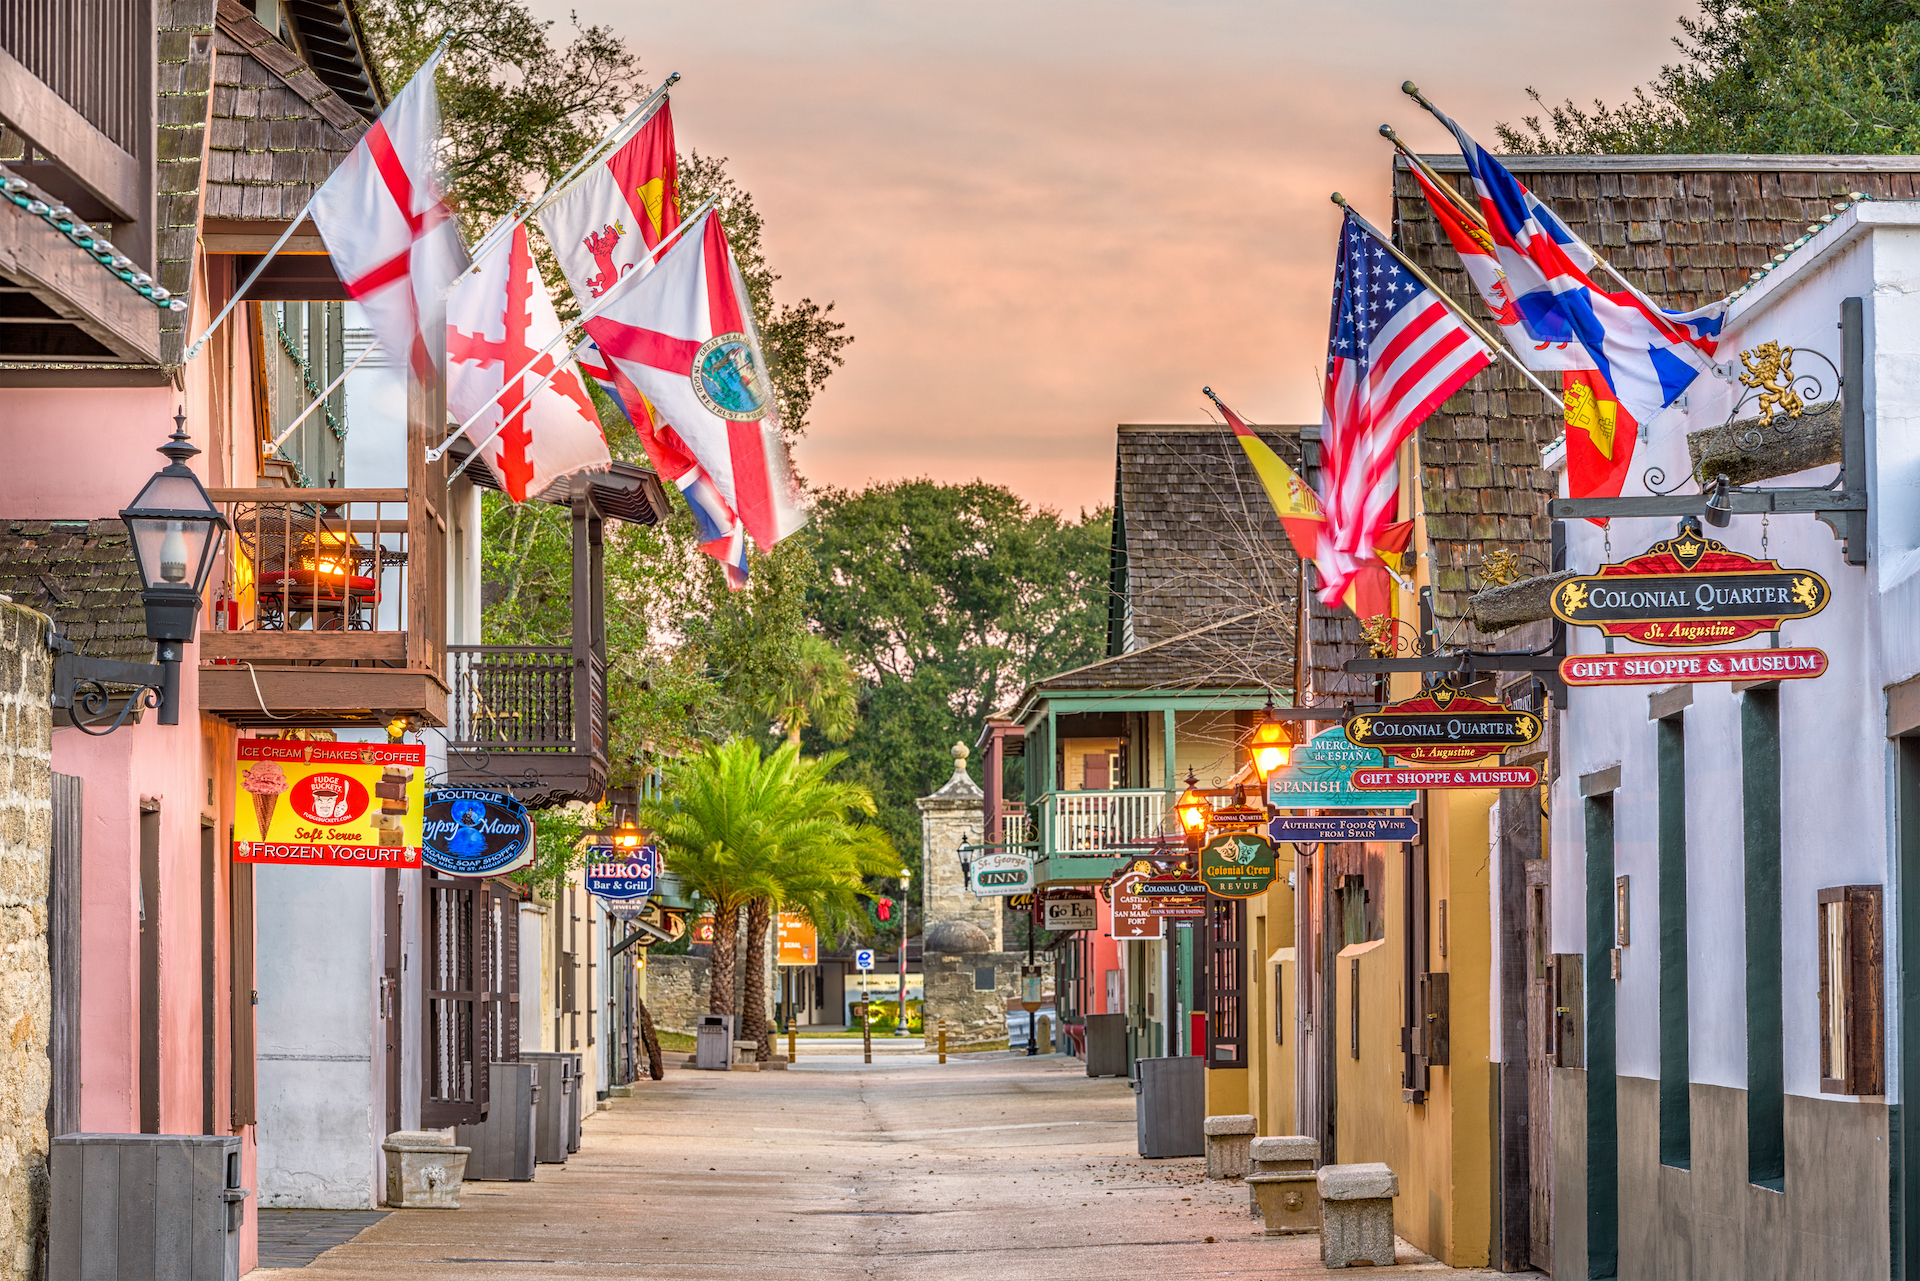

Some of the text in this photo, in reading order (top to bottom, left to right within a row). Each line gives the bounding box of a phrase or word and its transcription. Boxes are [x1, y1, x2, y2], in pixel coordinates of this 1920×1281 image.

[700, 339, 719, 357] GREAT
[694, 376, 703, 393] GOD
[712, 404, 739, 419] TRUST
[1589, 583, 1791, 612] COLONIAL QUARTER
[1644, 620, 1736, 640] St. Augustine
[1572, 654, 1817, 678] GIFT SHOPPE & MUSEUM
[1372, 719, 1515, 740] COLONIAL QUARTER
[242, 746, 420, 762] ICE CREAM SHAKES COFFEE
[1315, 751, 1371, 761] de ESPAÑA
[1411, 746, 1476, 759] St. Augustine
[314, 776, 339, 784] FUDGE
[1360, 771, 1531, 785] GIFT SHOPPE & MUSEUM
[311, 782, 343, 792] BUCKETS
[1273, 781, 1341, 794] SPANISH
[436, 790, 503, 804] BOUTIQUE
[303, 811, 352, 823] FUDGEBUCKETS.COM
[1238, 814, 1263, 823] QUARTER
[478, 818, 521, 835] Moon
[1281, 820, 1406, 830] AUTHENTIC FOOD & WINE
[294, 827, 362, 843] Soft Serve
[1319, 829, 1376, 838] FROM SPAIN
[252, 842, 402, 861] FROZEN YOGURT
[422, 841, 454, 865] ORGANIC
[483, 843, 517, 865] SHOPPE
[478, 852, 514, 870] AUGUSTINE
[978, 855, 1026, 870] St. George
[589, 863, 651, 879] HEROS
[987, 872, 1019, 884] INN
[1207, 865, 1271, 877] Colonial Crew
[593, 880, 648, 890] Bar & Grill
[1143, 884, 1206, 894] COLONIAL QUARTE
[1049, 904, 1067, 918] Go
[1070, 902, 1093, 918] Fish
